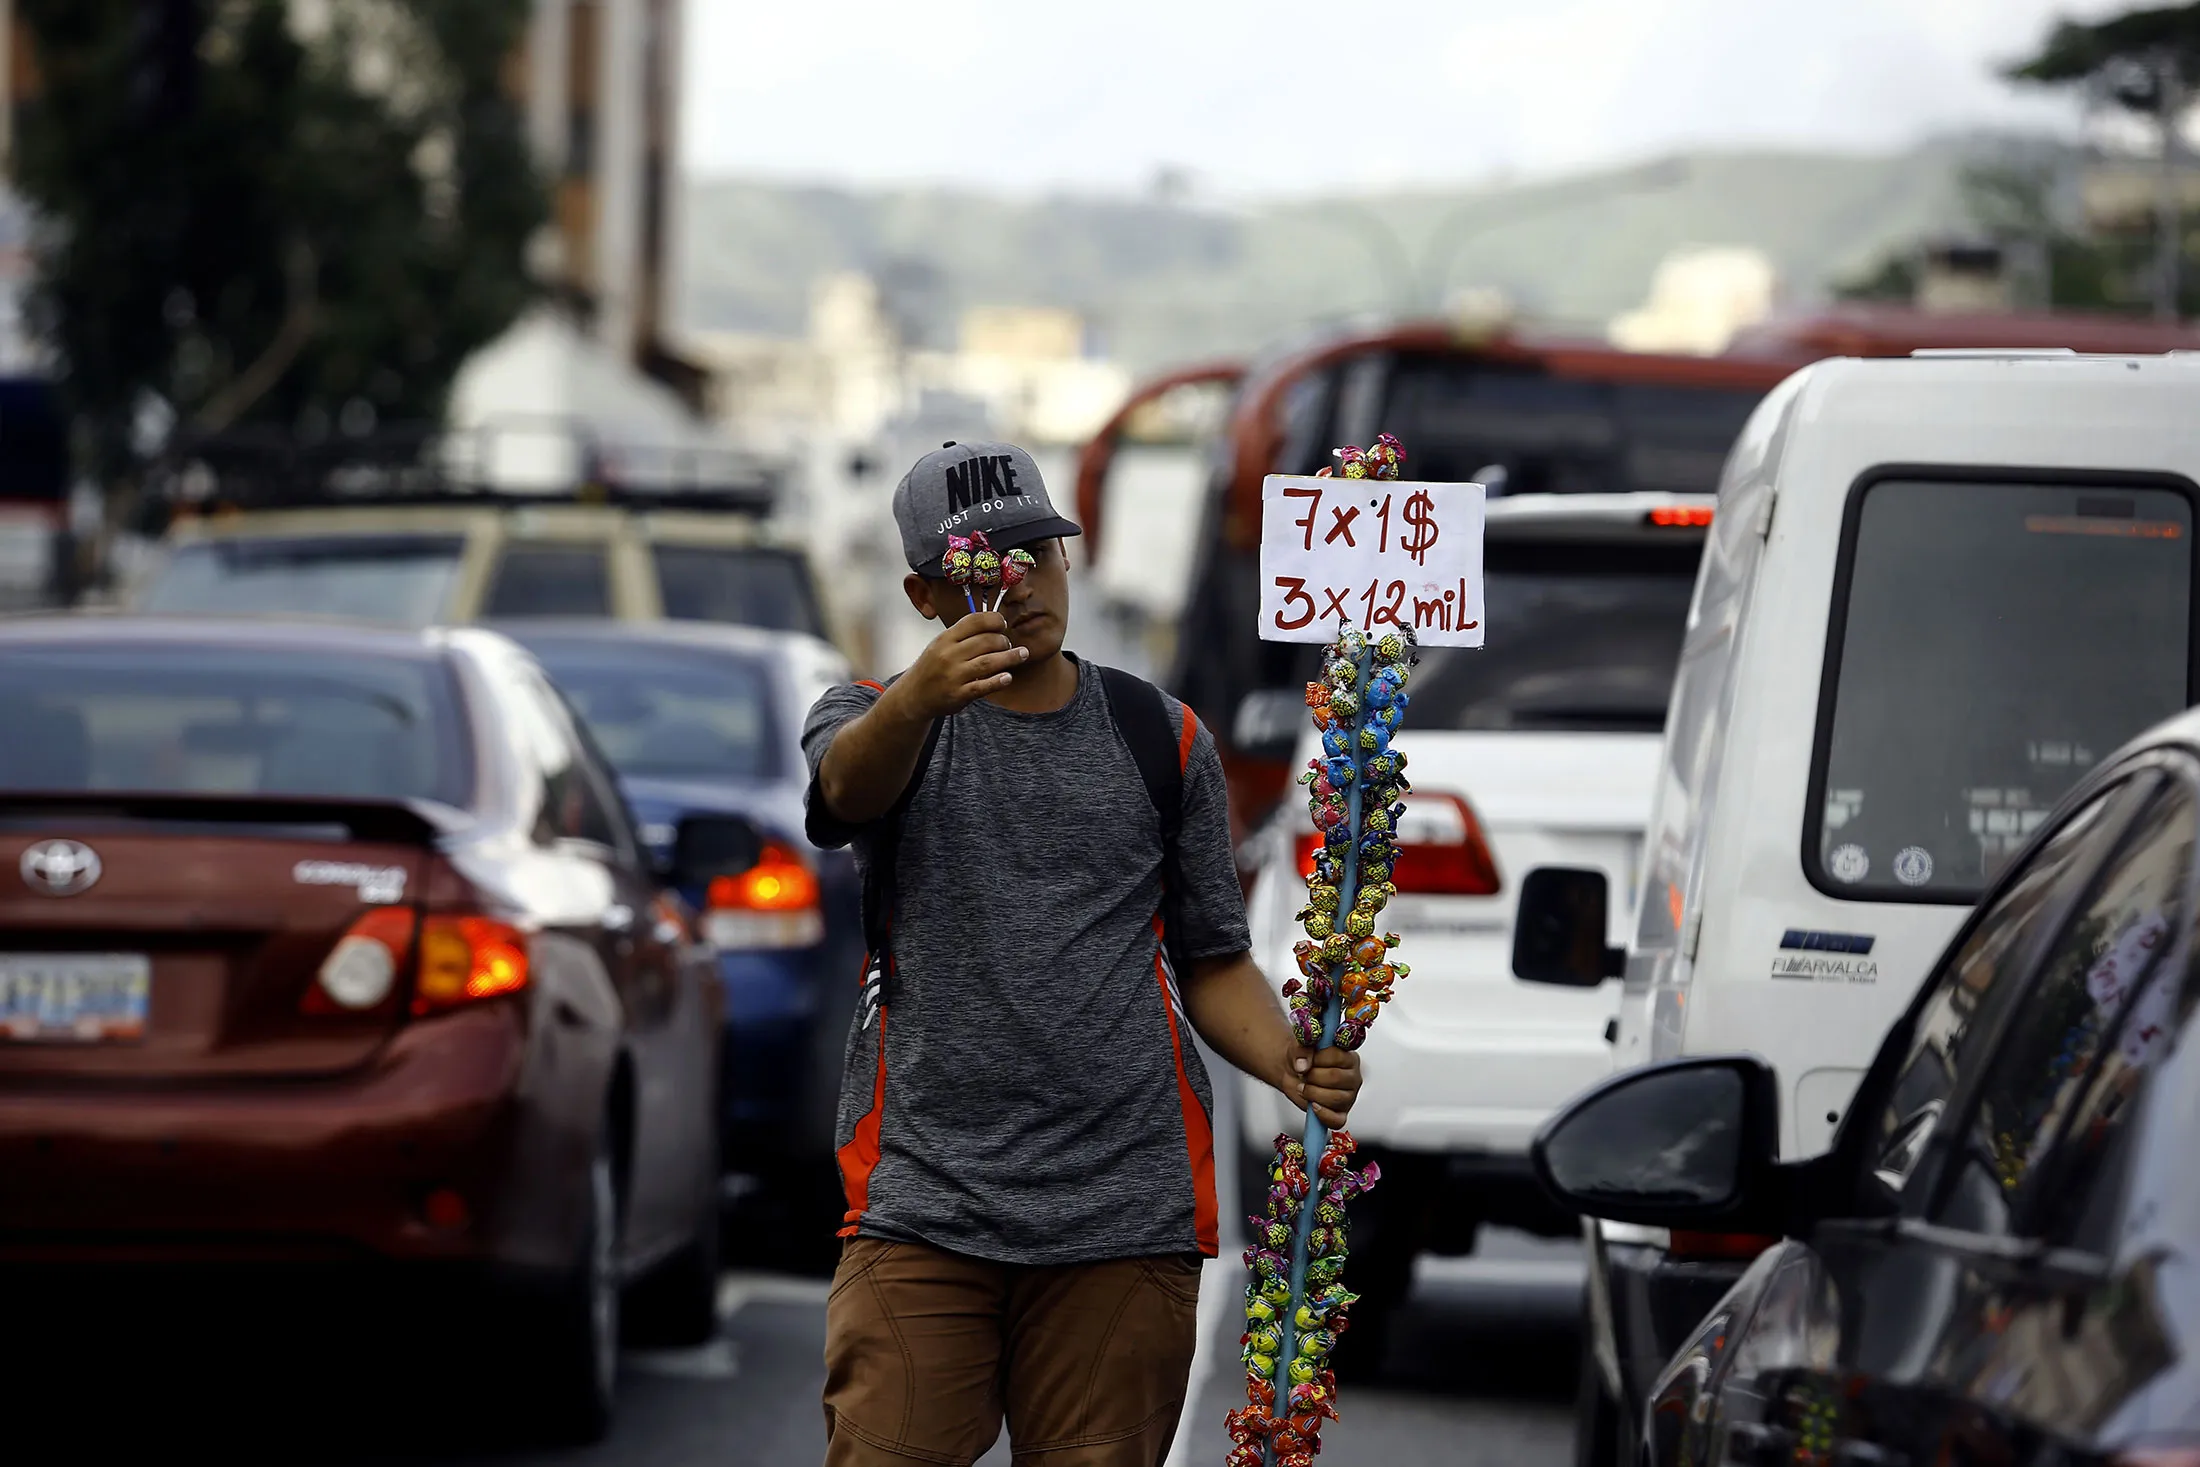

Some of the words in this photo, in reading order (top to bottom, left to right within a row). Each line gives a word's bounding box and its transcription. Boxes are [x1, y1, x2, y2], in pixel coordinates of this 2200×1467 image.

[946, 455, 1022, 514] NIKE
[936, 510, 970, 534] JUST
[981, 499, 1004, 513] DO
